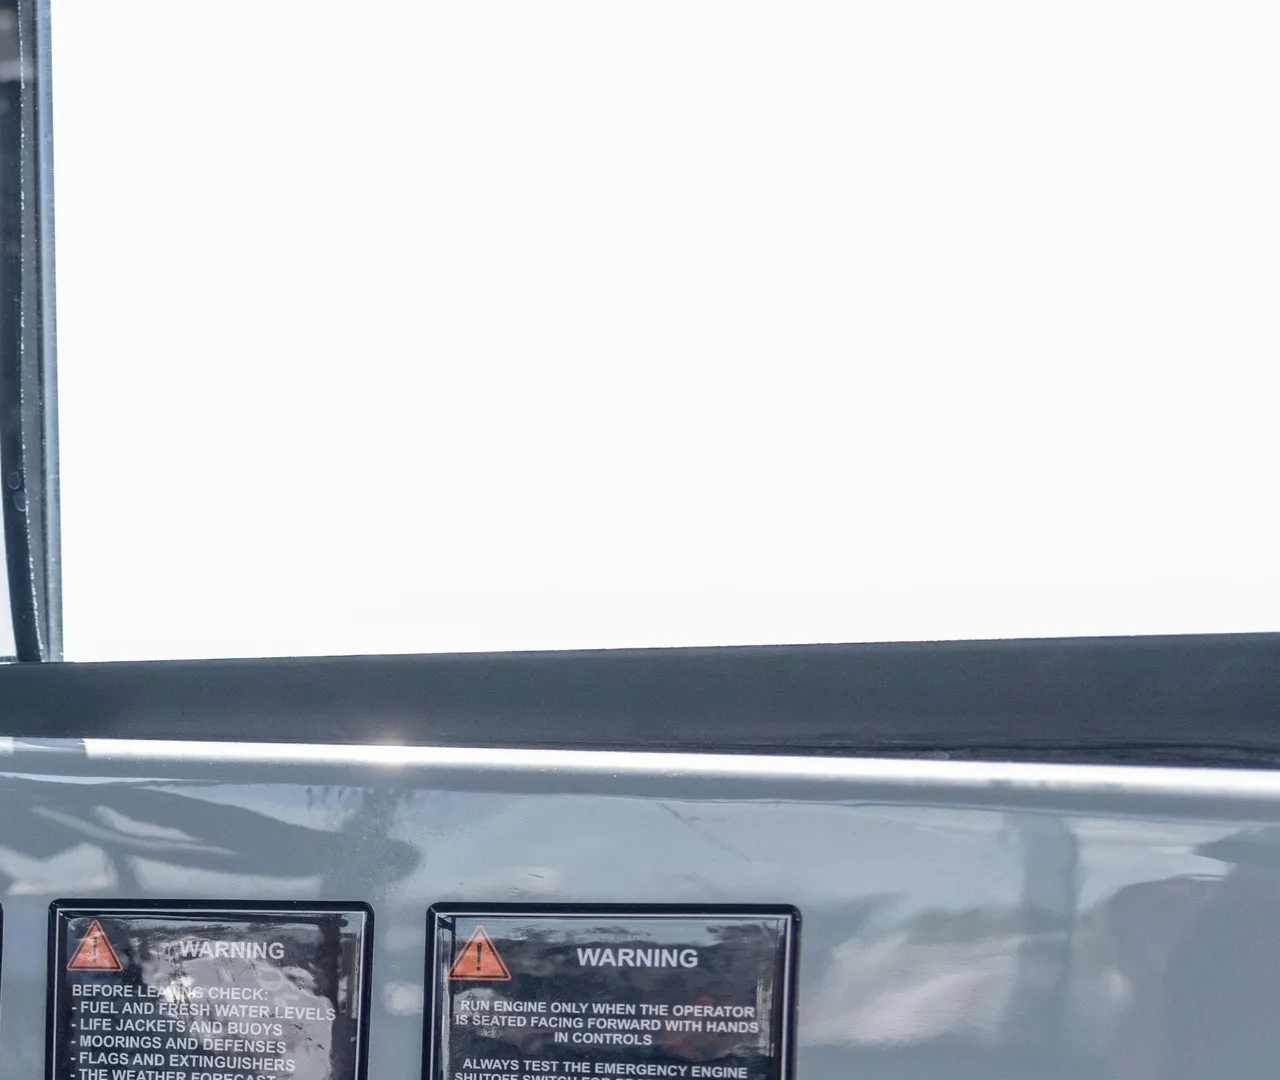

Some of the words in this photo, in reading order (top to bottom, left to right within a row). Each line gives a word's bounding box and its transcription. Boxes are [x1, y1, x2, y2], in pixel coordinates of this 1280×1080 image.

[179, 940, 284, 959] WARNING
[577, 948, 698, 968] WARNING
[72, 985, 133, 997] BEFORE
[138, 986, 204, 999] LEANG
[206, 987, 268, 1000] CHECK:
[80, 1002, 118, 1014] FUEL
[122, 1002, 154, 1014] AND
[159, 1004, 210, 1016] FRESH
[214, 1005, 269, 1018] WATER
[275, 1006, 336, 1020] LEVELS
[460, 1000, 490, 1012] RUN
[494, 1001, 546, 1013] ENGINE
[551, 1002, 589, 1014] ONLY
[592, 1003, 636, 1015] WHEN
[640, 1004, 668, 1016] THE
[672, 1005, 755, 1018] OPERATOR
[80, 1019, 111, 1030] LIFE
[116, 1020, 186, 1032] JACKETS
[190, 1021, 223, 1034] AND
[228, 1022, 282, 1036] BUOYS
[456, 1014, 468, 1025] IS
[472, 1015, 526, 1027] SEATED
[531, 1016, 584, 1029] FACING
[587, 1018, 661, 1031] FORWARD
[665, 1020, 702, 1032] WITH
[706, 1021, 758, 1033] HANDS
[80, 1036, 158, 1048] MOORINGS
[165, 1038, 198, 1050] AND
[203, 1038, 286, 1053] DEFENSES
[555, 1032, 568, 1043] IN
[572, 1032, 652, 1045] CONTROLS
[80, 1052, 128, 1065] FLAGS
[132, 1054, 165, 1066] AND
[170, 1055, 295, 1071] EXTINGUISHERS
[463, 1059, 519, 1071] ALWAYS
[523, 1060, 559, 1072] TEST
[563, 1061, 590, 1073] THE
[594, 1062, 687, 1076] EMERGENCY
[692, 1066, 748, 1079] ENGINE
[79, 1069, 108, 1080] THE
